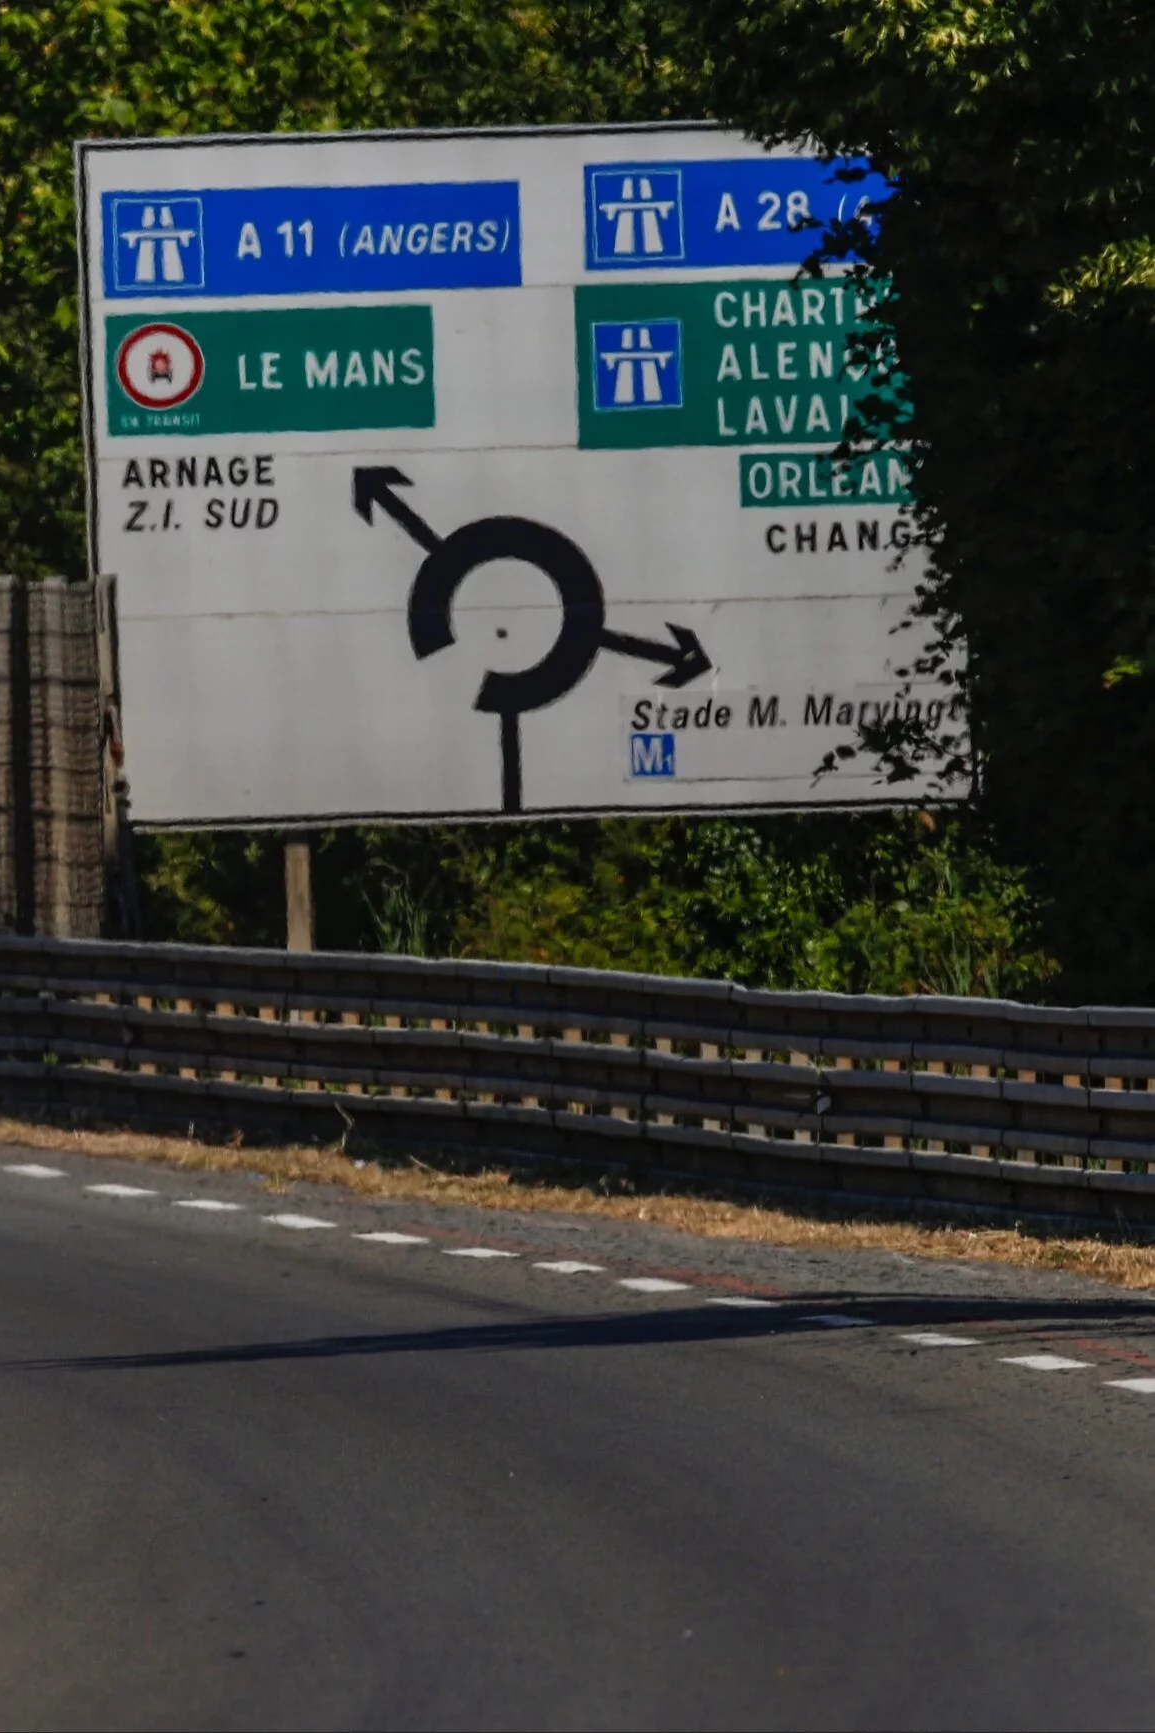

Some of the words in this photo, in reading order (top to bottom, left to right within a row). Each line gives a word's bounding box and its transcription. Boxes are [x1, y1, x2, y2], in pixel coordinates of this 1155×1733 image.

[715, 192, 740, 233] A
[757, 190, 809, 231] 28
[237, 222, 262, 259] A
[276, 219, 314, 257] 11
[339, 216, 511, 257] (ANGERS)
[238, 352, 282, 390] LE
[305, 348, 425, 388] MANS
[123, 456, 275, 488] ARNAGE
[749, 458, 913, 500] ORLEAN
[123, 501, 181, 531] Z.I.
[205, 499, 279, 530] SUD
[765, 520, 913, 554] CHANG
[631, 699, 731, 731] Stade
[748, 696, 787, 728] M.
